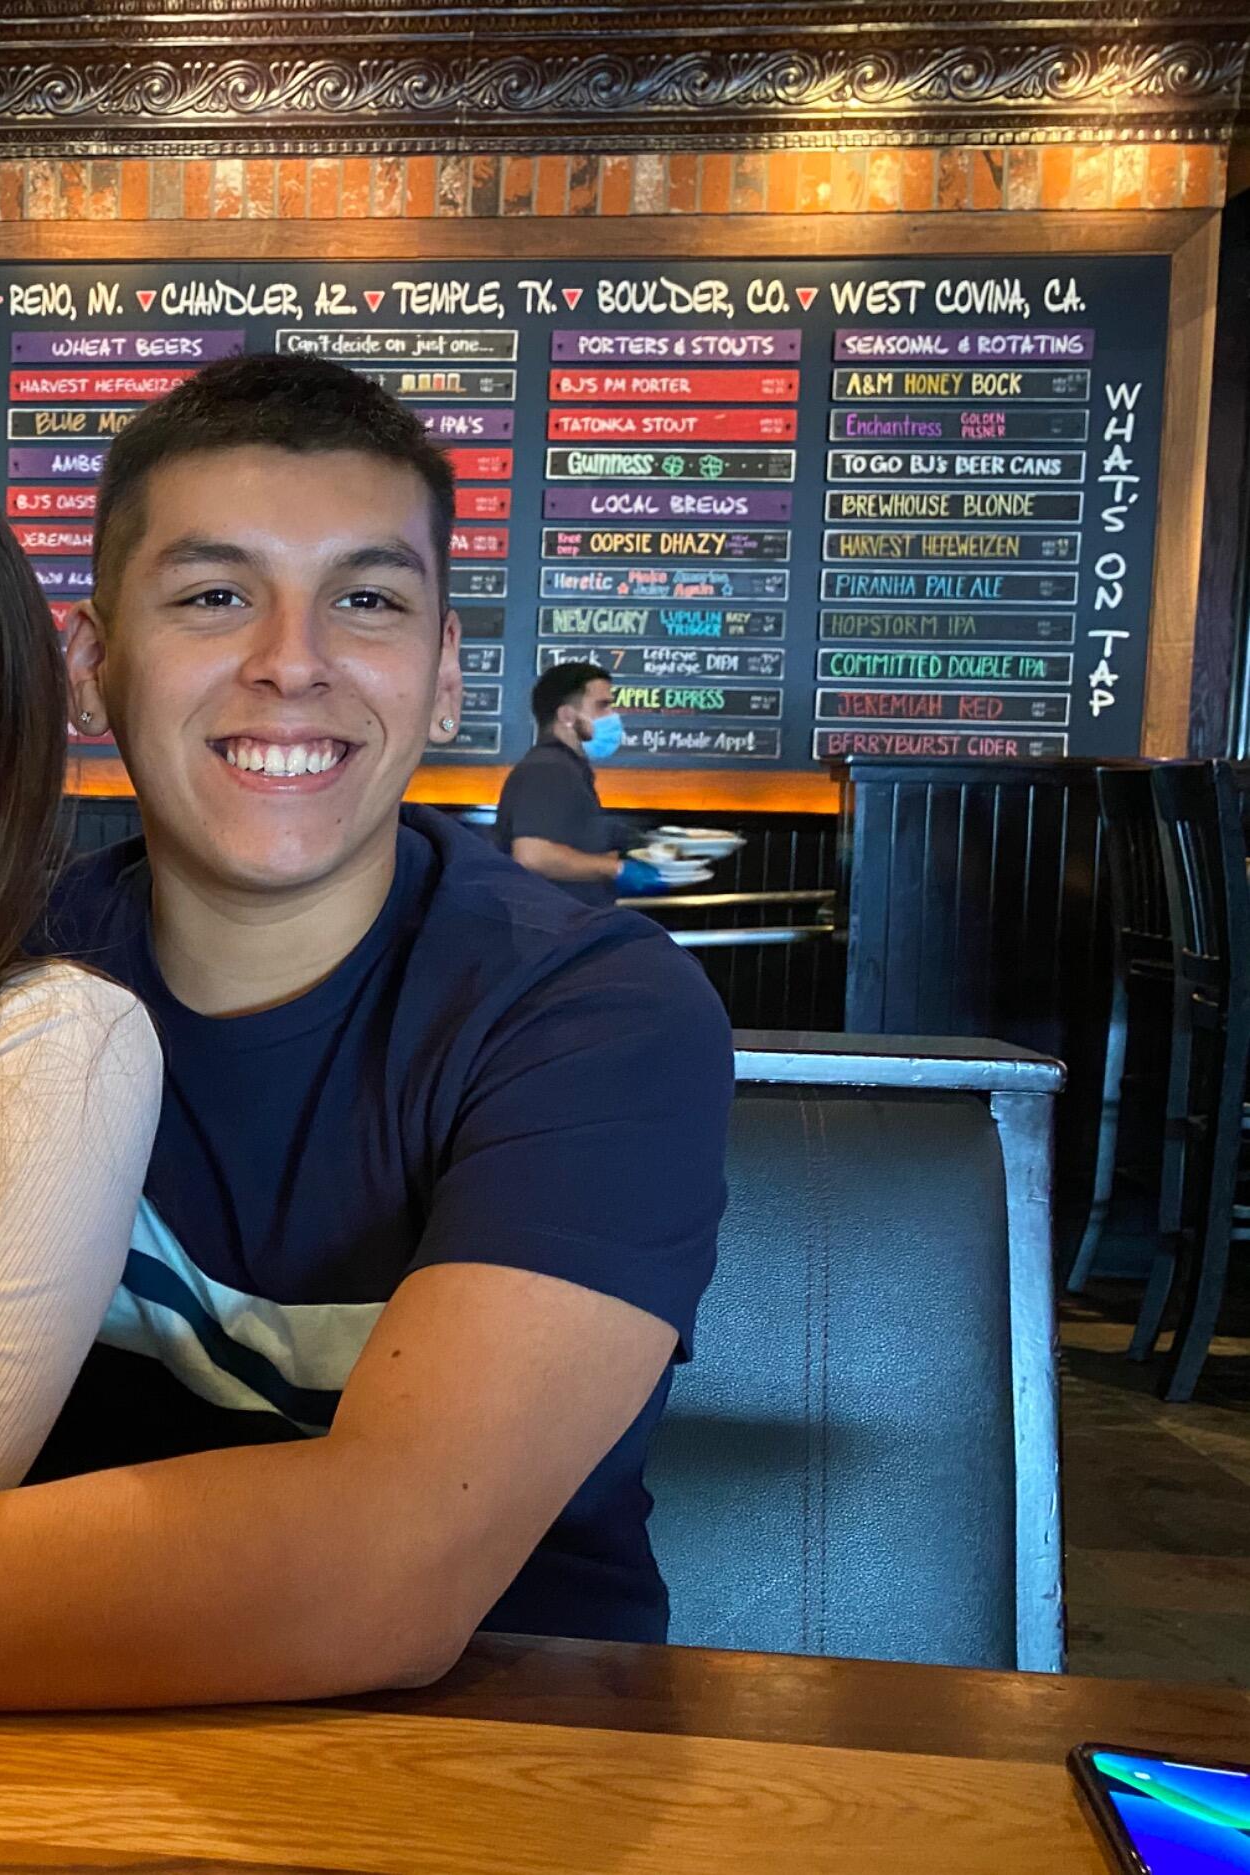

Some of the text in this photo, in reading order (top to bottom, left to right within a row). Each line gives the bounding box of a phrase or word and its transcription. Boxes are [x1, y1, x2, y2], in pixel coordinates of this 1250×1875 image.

[9, 282, 77, 321] RENO,
[87, 282, 123, 316] NV.
[161, 279, 304, 321] CHANDLER,
[314, 281, 357, 316] AZ.
[391, 280, 505, 320] TEMPLE,
[517, 278, 558, 314] TX.
[597, 276, 734, 319] BOULDER,
[746, 279, 790, 314] CO.
[830, 280, 926, 315] WEST
[935, 278, 1030, 319] COVINA,
[1044, 278, 1086, 315] CA.
[51, 338, 203, 356] WHEAT BEERS
[332, 334, 381, 354] decide
[384, 338, 406, 352] on
[411, 334, 446, 356] just
[578, 336, 669, 355] PORTERS
[691, 336, 775, 356] STOUTS
[844, 335, 949, 355] SEASONAL
[977, 335, 1085, 355] ROTATING
[19, 377, 186, 394] HARVEST HEFEWEIZE
[560, 377, 691, 393] BJ'S PM PORTER
[846, 372, 1023, 396] A&M HONEY BOCK
[98, 411, 136, 433] Mo
[440, 416, 484, 435] IPA'S
[558, 417, 698, 433] TATONKA STOUT
[846, 413, 942, 437] Enchantress
[960, 412, 1005, 425] GOLDEN
[961, 425, 1005, 439] PILSNER
[51, 454, 104, 472] AMBE
[841, 454, 867, 473] TO
[870, 455, 903, 474] GO
[955, 456, 1004, 475] BEER
[1010, 457, 1062, 475] CANS
[16, 494, 51, 510] BJ'S
[591, 494, 749, 515] LOCAL BREWS
[841, 493, 1036, 517] BREWHOUSE BLONDE
[590, 532, 727, 555] OOPSIE DHAZY
[840, 534, 914, 557] HARVEST
[922, 535, 1020, 558] HEFEWEIZEN
[554, 571, 613, 590] Heretic
[835, 575, 1004, 598] PIRANHA PALE ALE
[1095, 552, 1127, 611] ON
[552, 608, 649, 635] NEW GLORY
[831, 614, 977, 636] HOPSTORM IPA
[610, 649, 626, 670] 7
[830, 652, 1047, 679] COMMITTED DOUBLE IPA
[1088, 630, 1130, 717] TAP
[665, 688, 725, 710] EXPRESS
[837, 692, 942, 717] JEREMIAH
[958, 695, 1003, 719] RED
[827, 733, 961, 756] BERRYBURST
[967, 736, 1018, 757] CIDER
